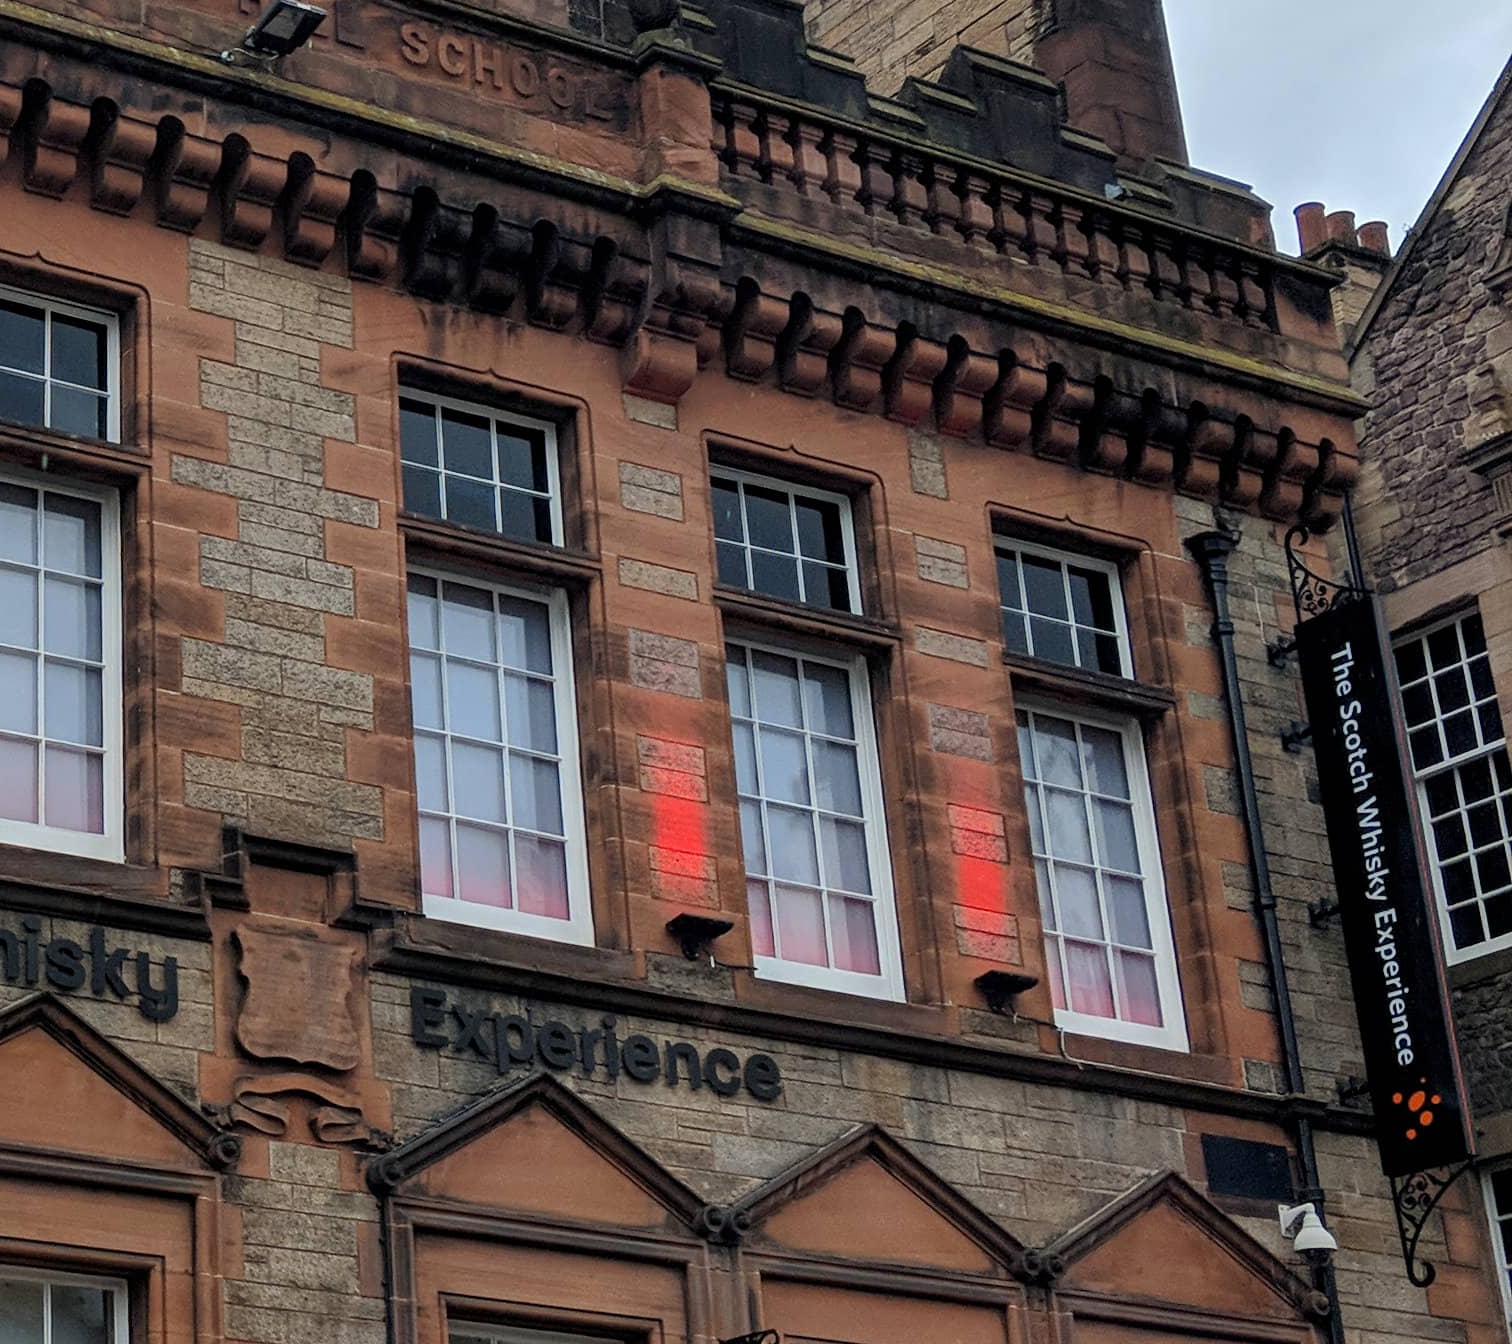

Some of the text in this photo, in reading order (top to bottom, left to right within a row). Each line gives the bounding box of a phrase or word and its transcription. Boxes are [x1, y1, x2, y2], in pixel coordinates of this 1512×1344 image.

[399, 21, 614, 122] SCHOOL
[1330, 642, 1415, 1067] The Scotch Whisky Experience
[409, 986, 783, 1102] Experience
